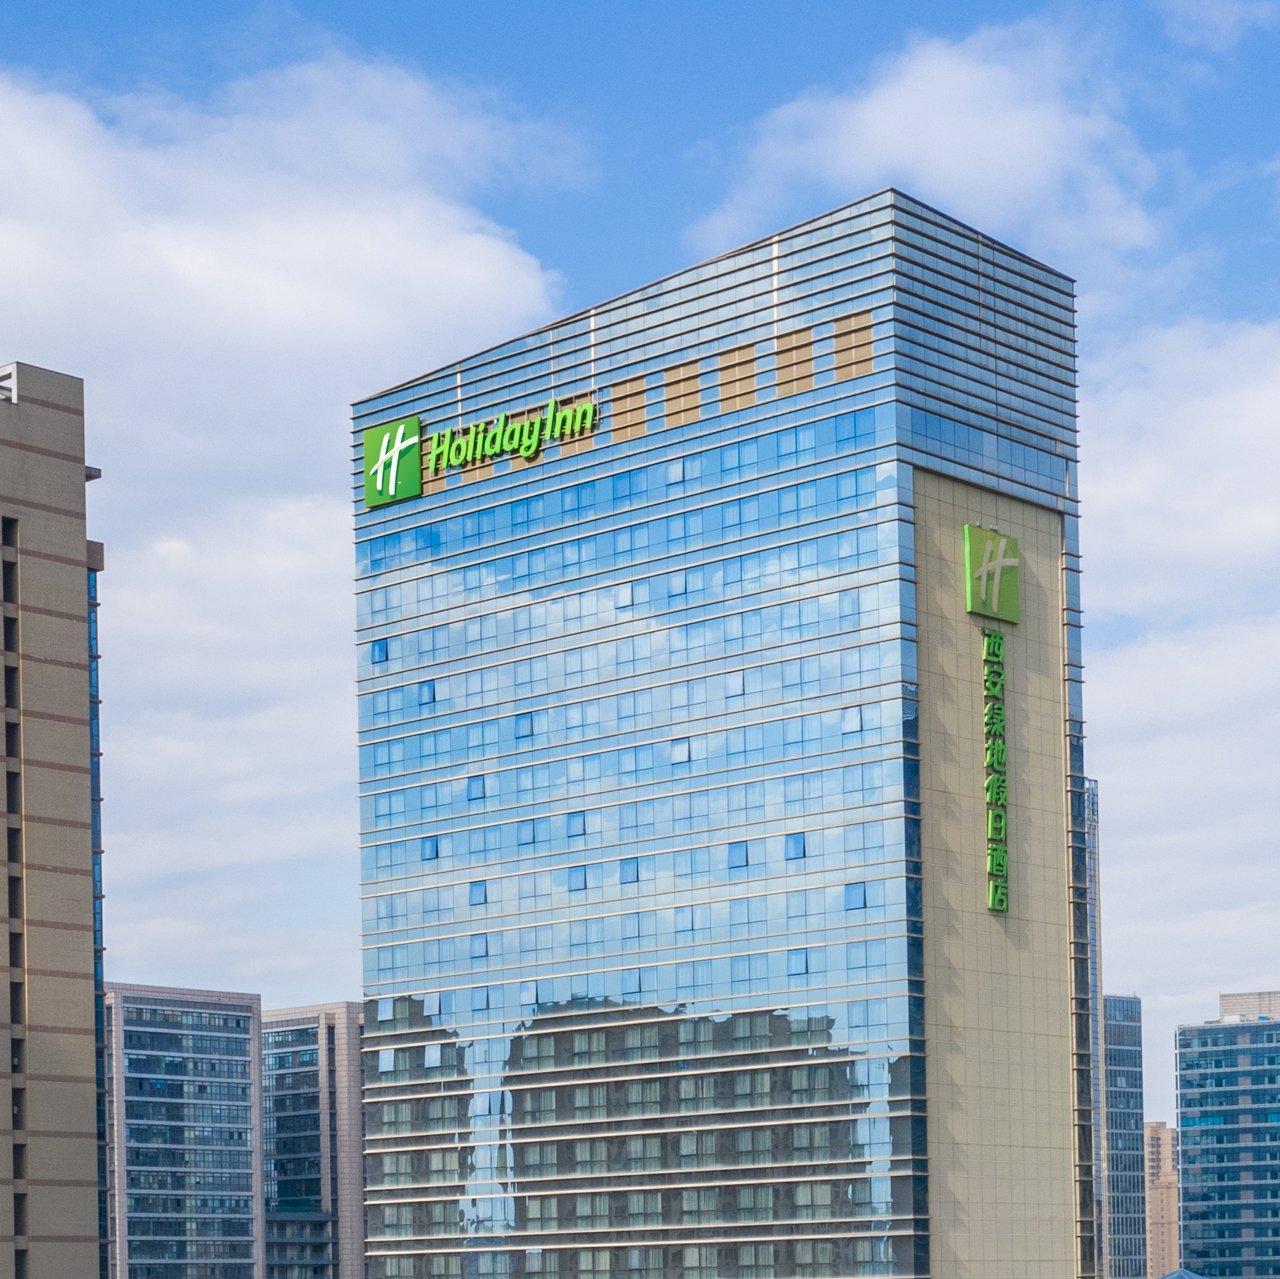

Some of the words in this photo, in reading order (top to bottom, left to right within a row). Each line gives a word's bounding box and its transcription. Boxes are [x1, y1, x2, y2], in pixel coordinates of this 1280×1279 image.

[428, 412, 543, 473] Holiday
[543, 399, 597, 441] Inn
[982, 629, 1009, 912] 西安绿地假日酒店
